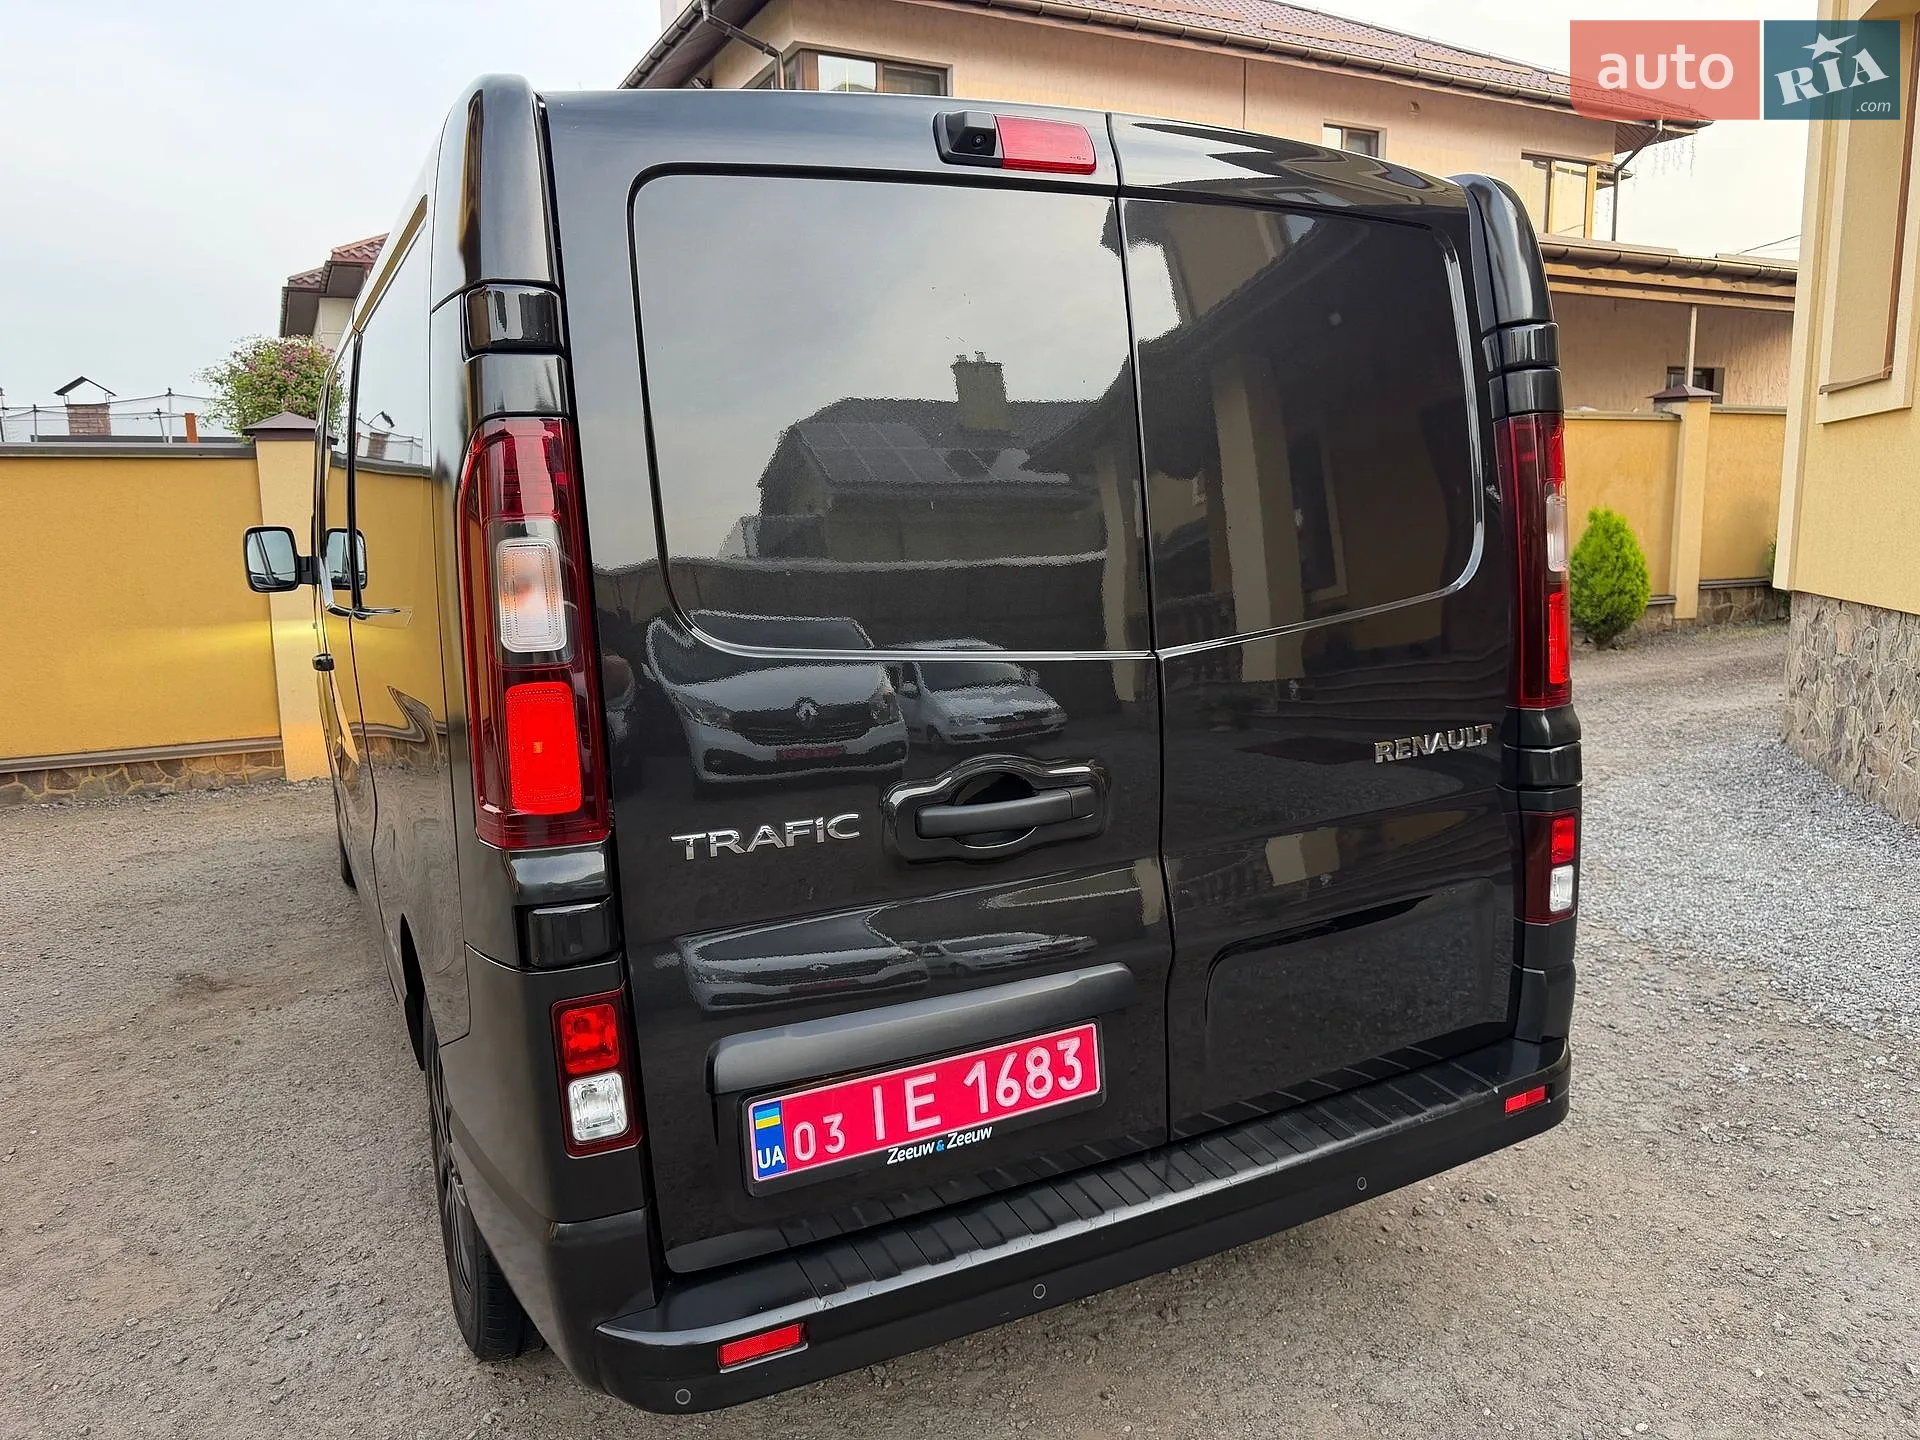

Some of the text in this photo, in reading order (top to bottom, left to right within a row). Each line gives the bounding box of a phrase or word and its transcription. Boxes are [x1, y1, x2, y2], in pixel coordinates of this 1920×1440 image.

[1374, 723, 1493, 764] RENAULT
[670, 813, 861, 861] TRAFIC
[793, 1037, 1083, 1162] 03 IE 1683
[757, 1145, 785, 1170] UA
[886, 1125, 993, 1165] Zeeuw & Zeeuw
